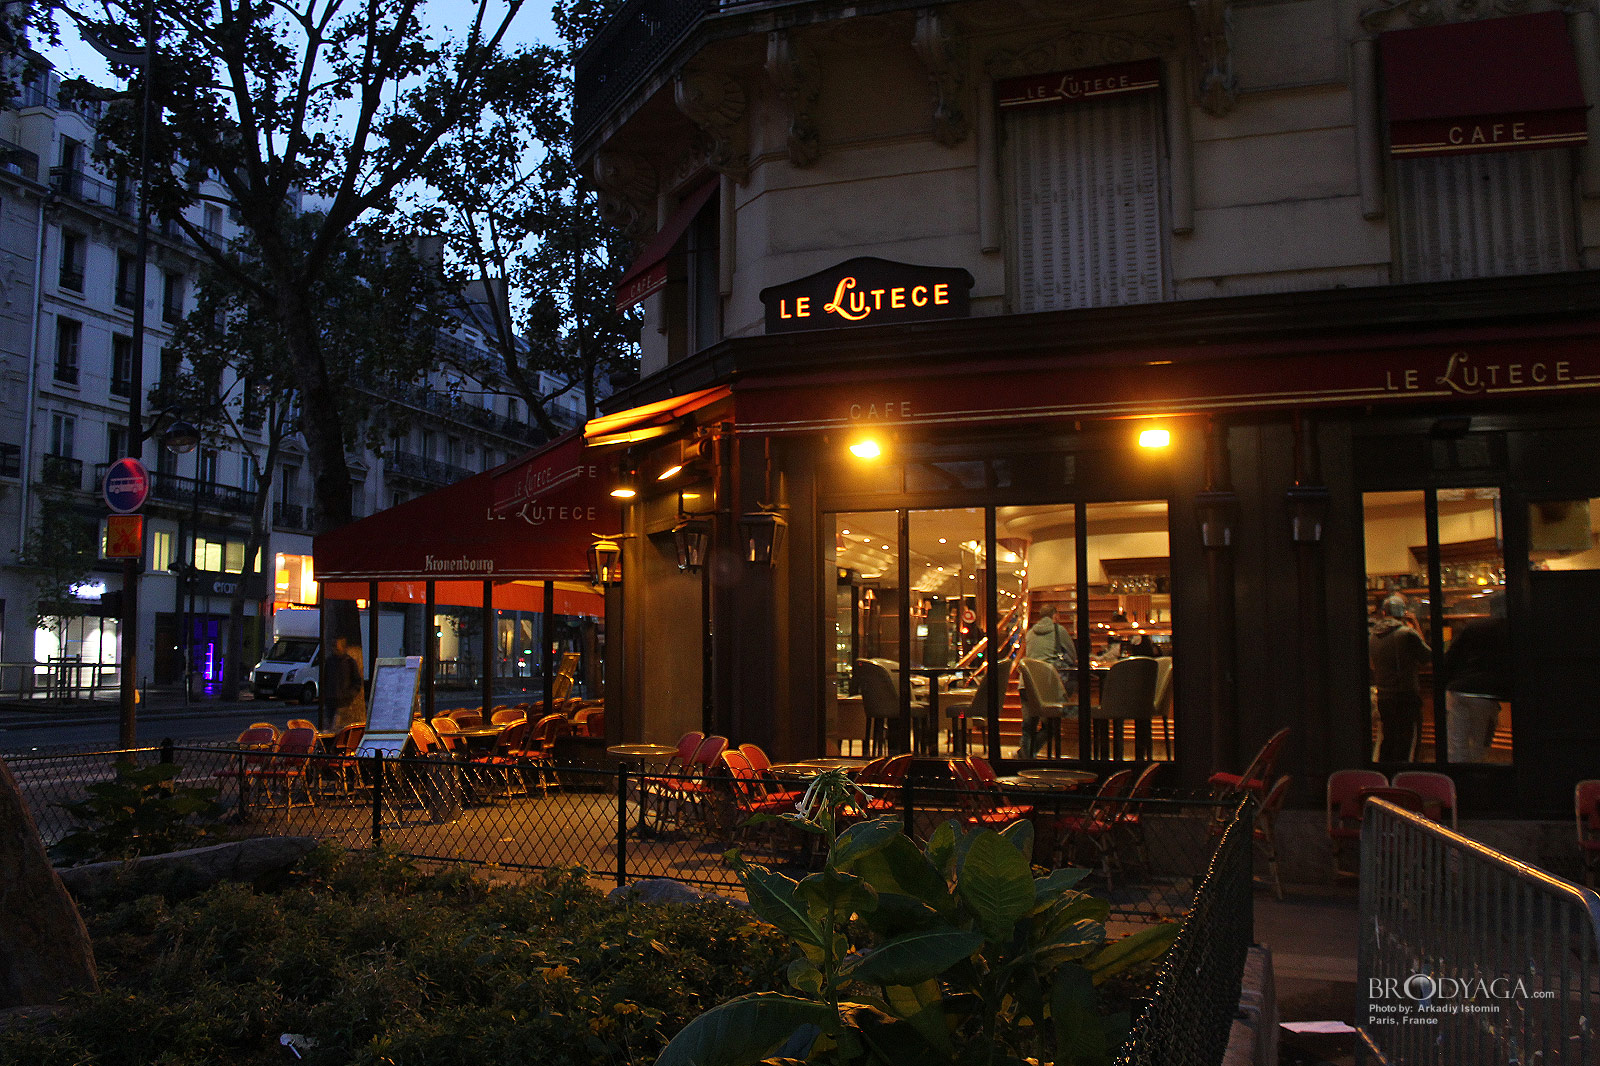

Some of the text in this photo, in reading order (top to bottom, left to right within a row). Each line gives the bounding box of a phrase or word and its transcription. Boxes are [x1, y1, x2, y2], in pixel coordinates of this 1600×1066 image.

[1026, 75, 1129, 100] LE LUTECE
[1449, 122, 1527, 145] CAFE
[630, 275, 652, 298] CAFE
[780, 276, 950, 321] LE LUTECE
[1386, 351, 1571, 395] LE LUTECE
[850, 401, 912, 420] CAFE
[515, 499, 597, 526] LUTECE
[424, 554, 494, 575] Kronenbourg
